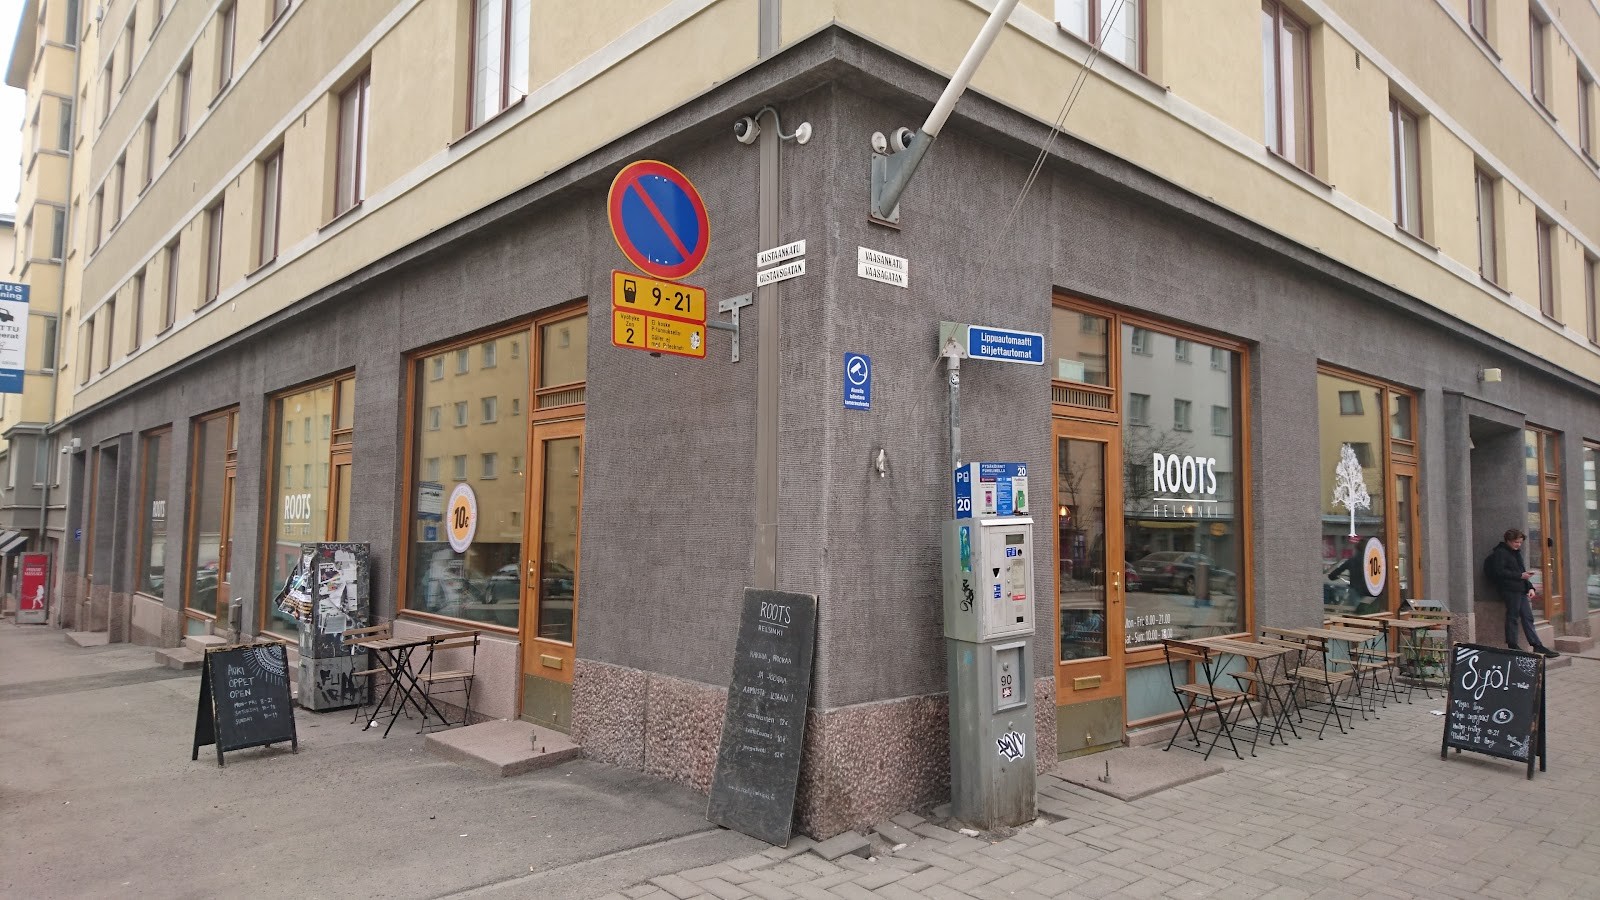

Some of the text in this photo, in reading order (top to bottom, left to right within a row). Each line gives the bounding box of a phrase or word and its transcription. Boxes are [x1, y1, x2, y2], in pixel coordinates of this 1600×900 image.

[865, 250, 903, 270] VAASANKATU
[625, 327, 635, 345] 2
[981, 332, 1032, 347] Lippuautomaatti
[981, 345, 1032, 359] Biljettautomat
[1017, 467, 1026, 477] 20
[1153, 452, 1217, 495] ROOTS
[284, 493, 311, 520] ROOTS
[957, 498, 971, 512] 20
[1153, 504, 1218, 518] HELSINKI
[760, 601, 791, 624] ROOTS
[758, 624, 783, 636] HELSINKI
[1000, 675, 1012, 686] 90
[230, 689, 251, 698] OPEN
